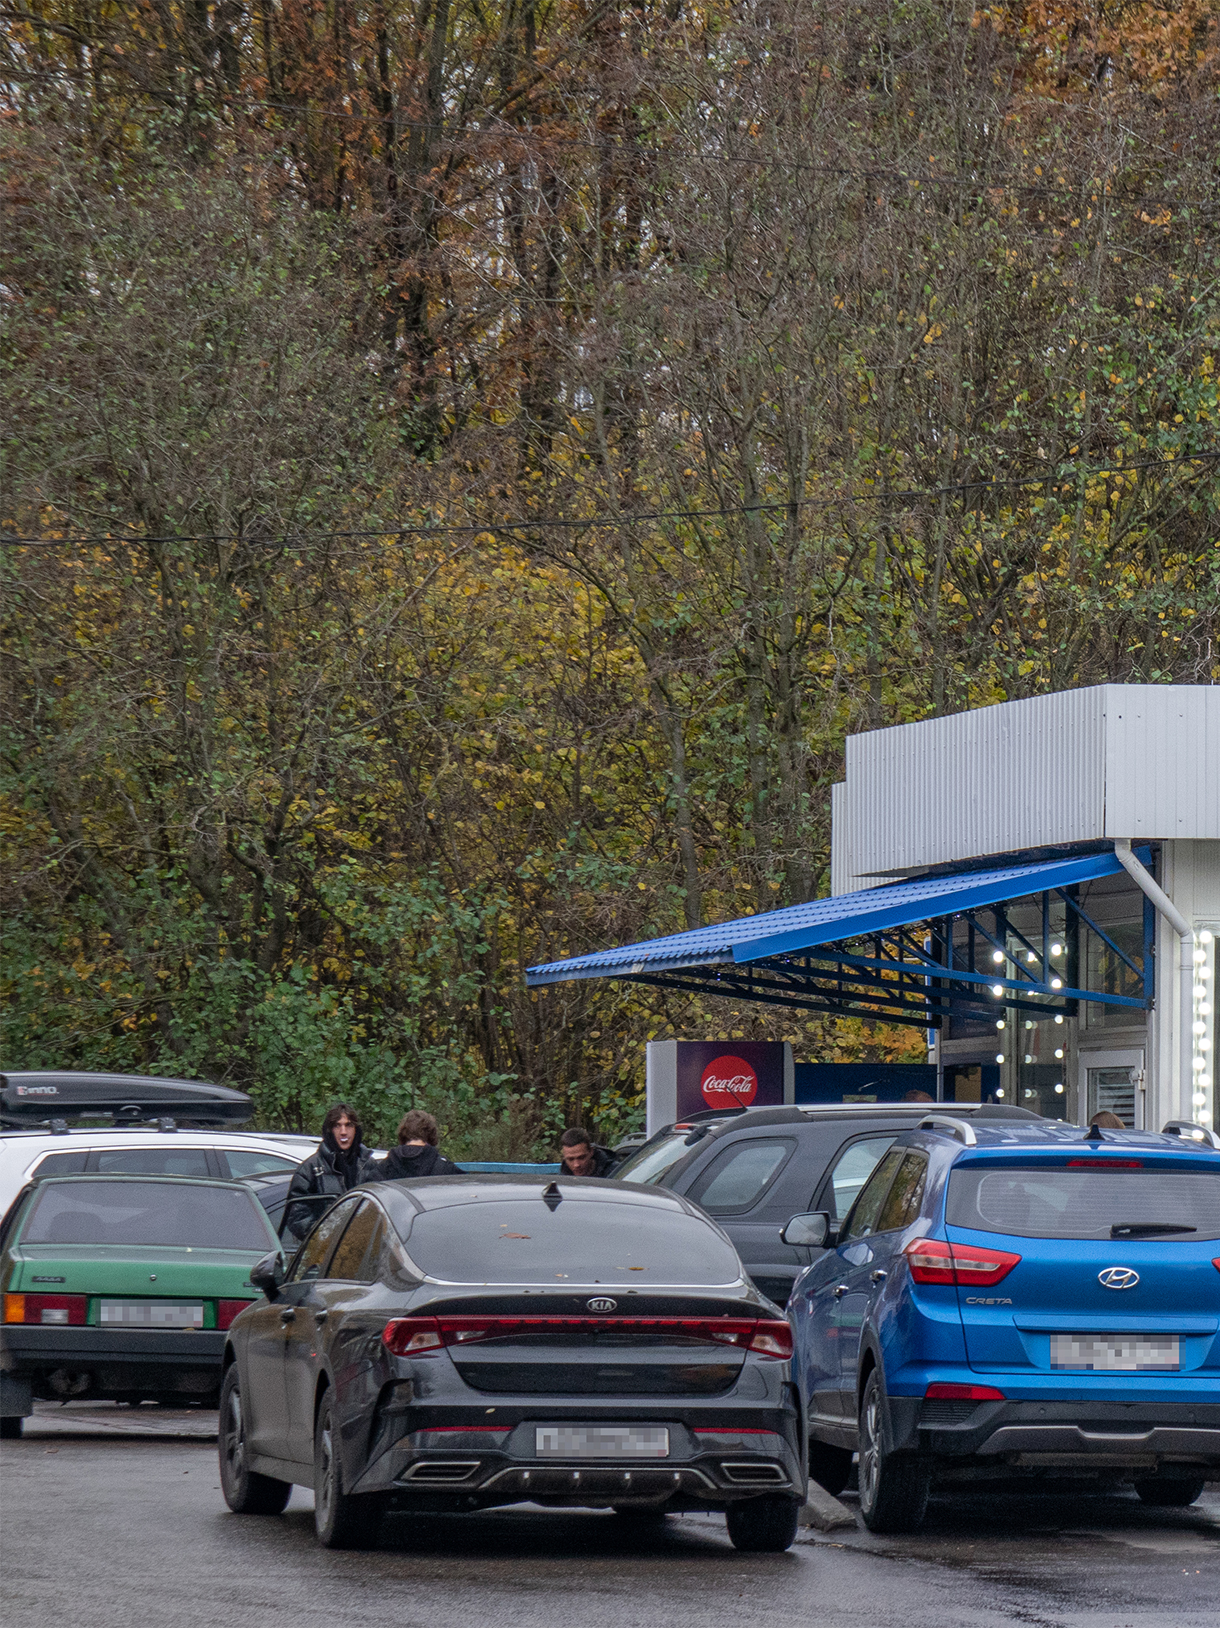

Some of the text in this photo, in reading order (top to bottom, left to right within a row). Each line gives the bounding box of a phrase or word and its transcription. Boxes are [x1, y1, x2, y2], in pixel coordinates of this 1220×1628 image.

[703, 1075, 754, 1092] Coca-Cola
[591, 1301, 612, 1310] KIA
[965, 1297, 1013, 1305] CRETA
